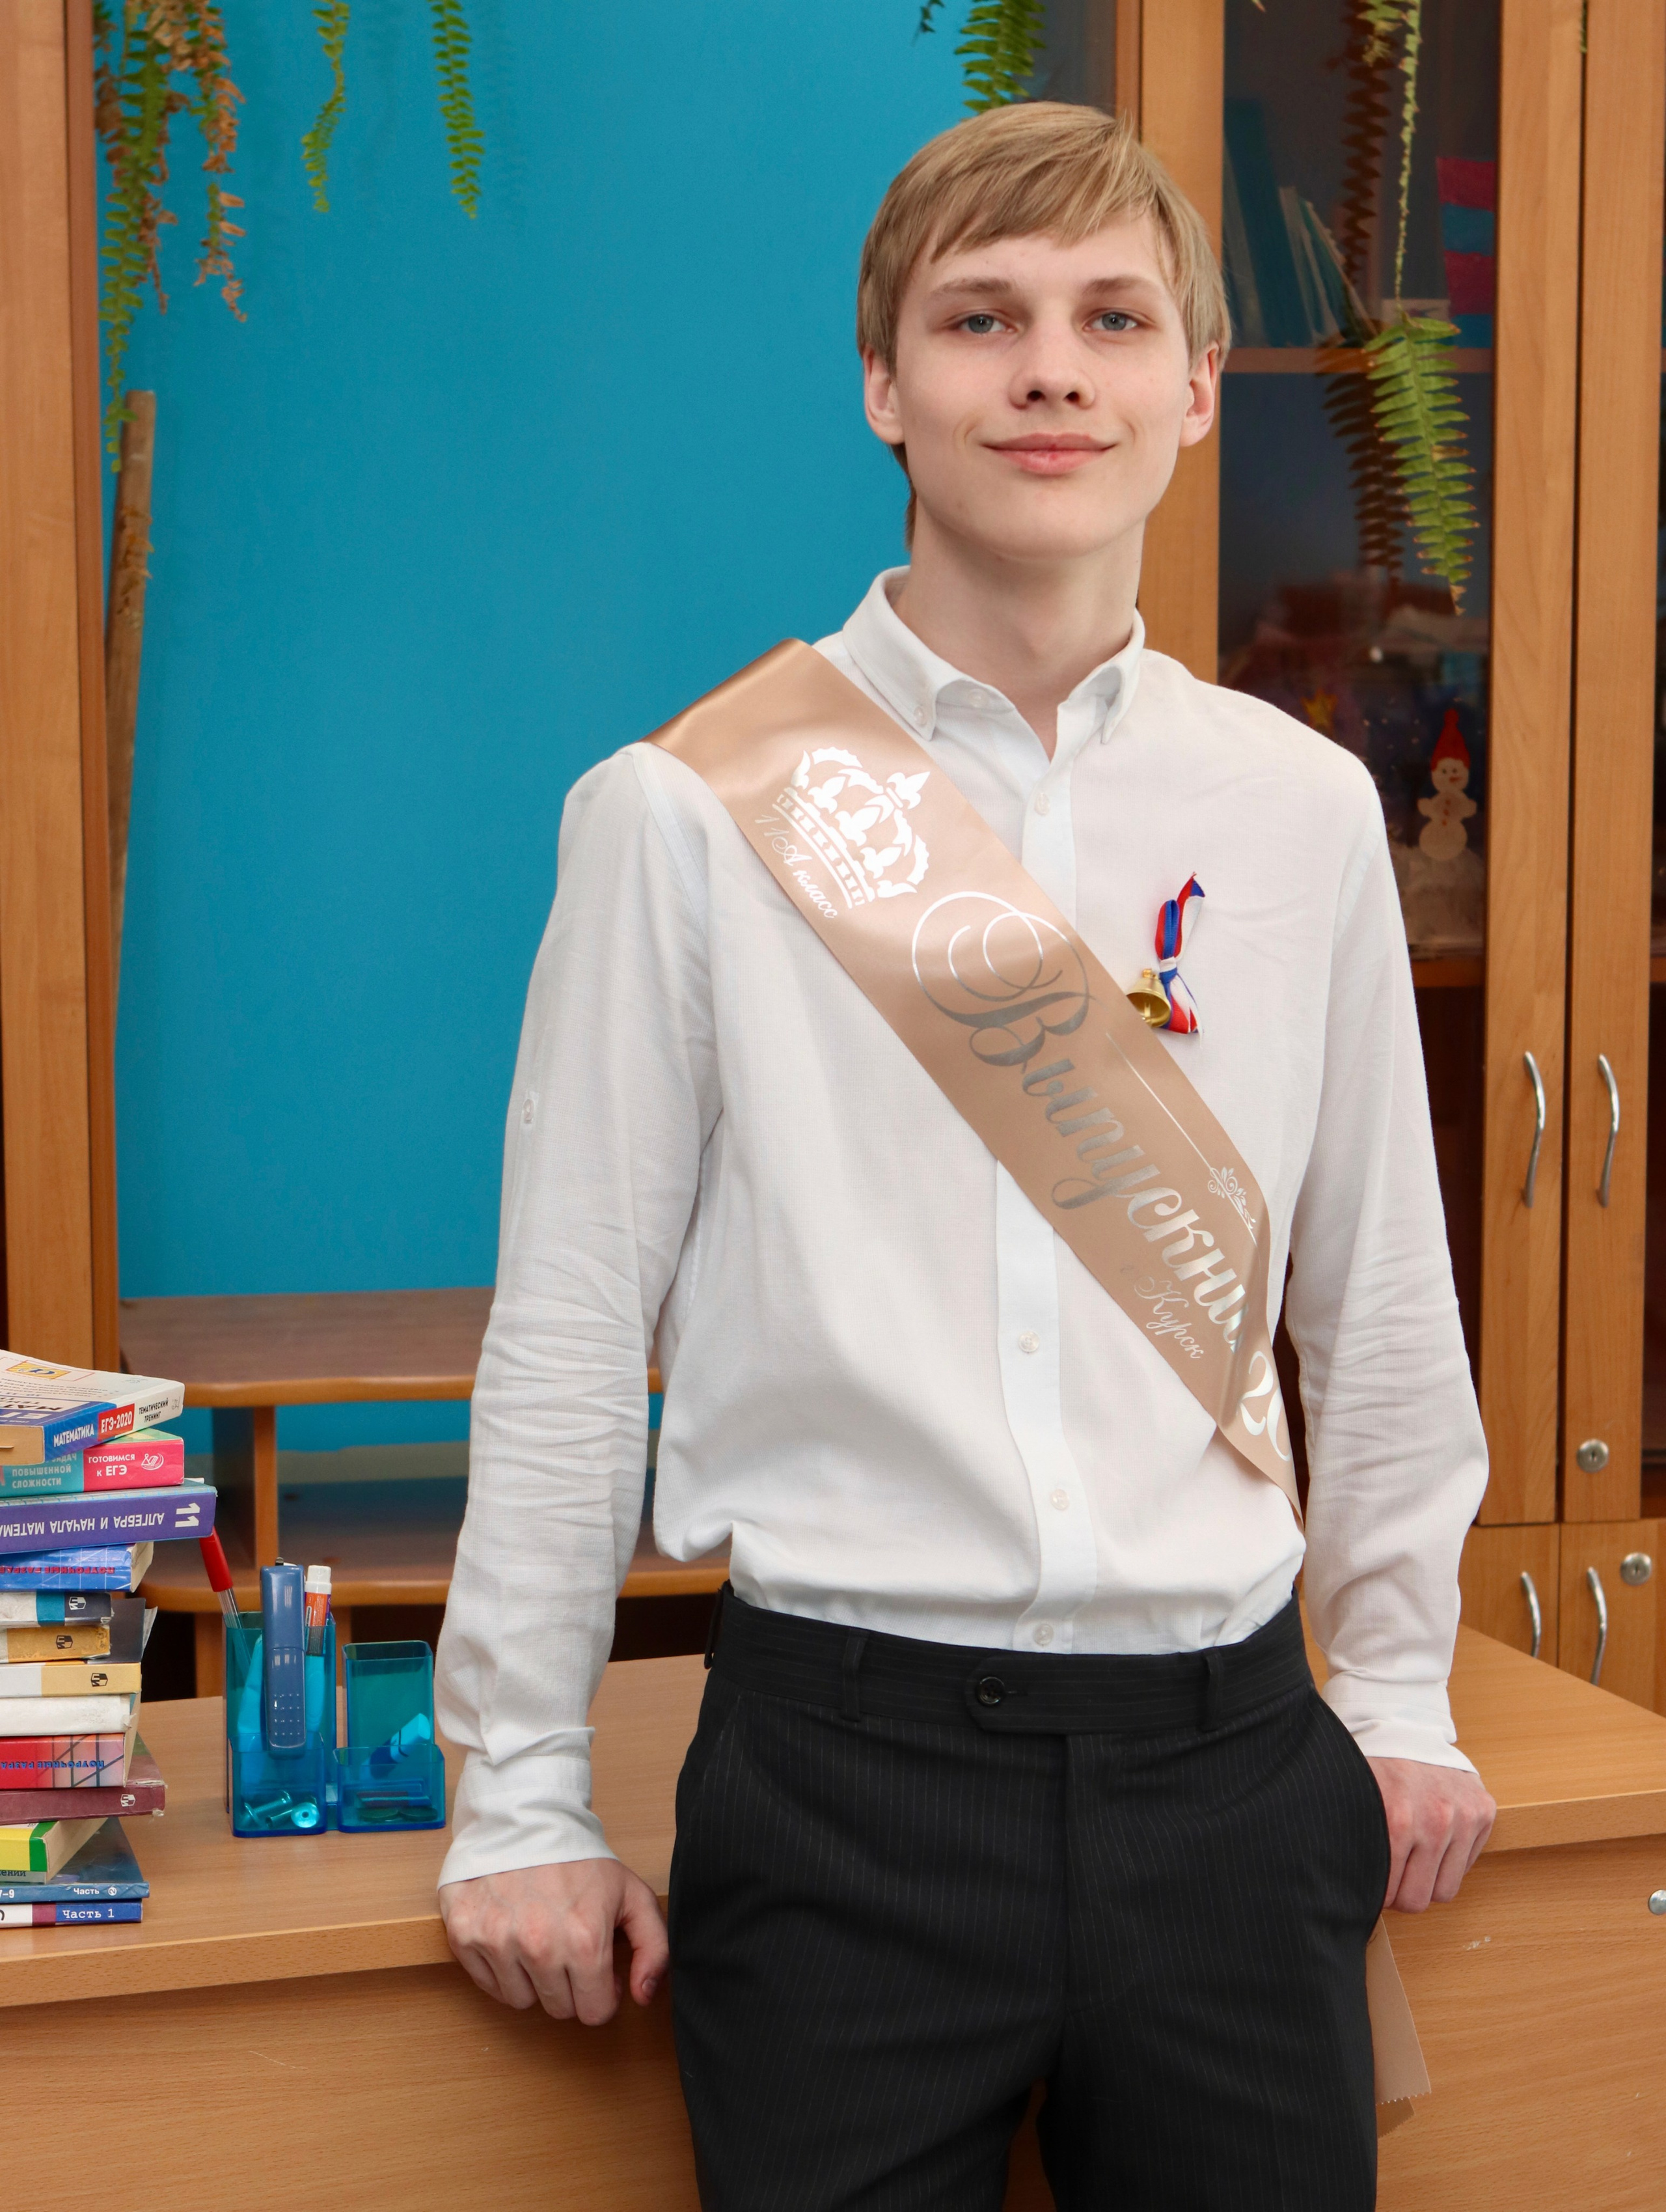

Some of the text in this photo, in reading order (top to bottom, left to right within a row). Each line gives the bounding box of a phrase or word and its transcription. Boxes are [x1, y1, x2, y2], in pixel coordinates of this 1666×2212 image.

[792, 869, 838, 919] класс
[912, 891, 1250, 1354] Выпускни
[1134, 1275, 1205, 1360] Курск
[139, 1397, 169, 1415] ТЕМАТИЧЕСКИЙ
[101, 1411, 133, 1433] ЕГЭ-2020
[144, 1411, 161, 1423] ТРЕНИНГ
[53, 1423, 95, 1448] МАТЕМАТИКА
[88, 1453, 135, 1464] ГОТОВИМСЯ
[12, 1463, 72, 1477] ПОВЫШЕННОЙ
[105, 1464, 128, 1476] ЕГЭ
[12, 1477, 62, 1489] СЛОЖНОСТИ
[113, 1512, 165, 1529] АЛГЕБРА
[174, 1502, 200, 1528] 11
[49, 1517, 96, 1534] НАЧАЛА
[100, 1517, 109, 1529] И
[44, 1566, 115, 1575] ПОУРОЧНЫЕ
[1, 1760, 105, 1769] ПОУРОЧНЫЕ РАЗРА
[74, 1887, 100, 1896] Часть
[62, 1908, 115, 1919] Часть 1
